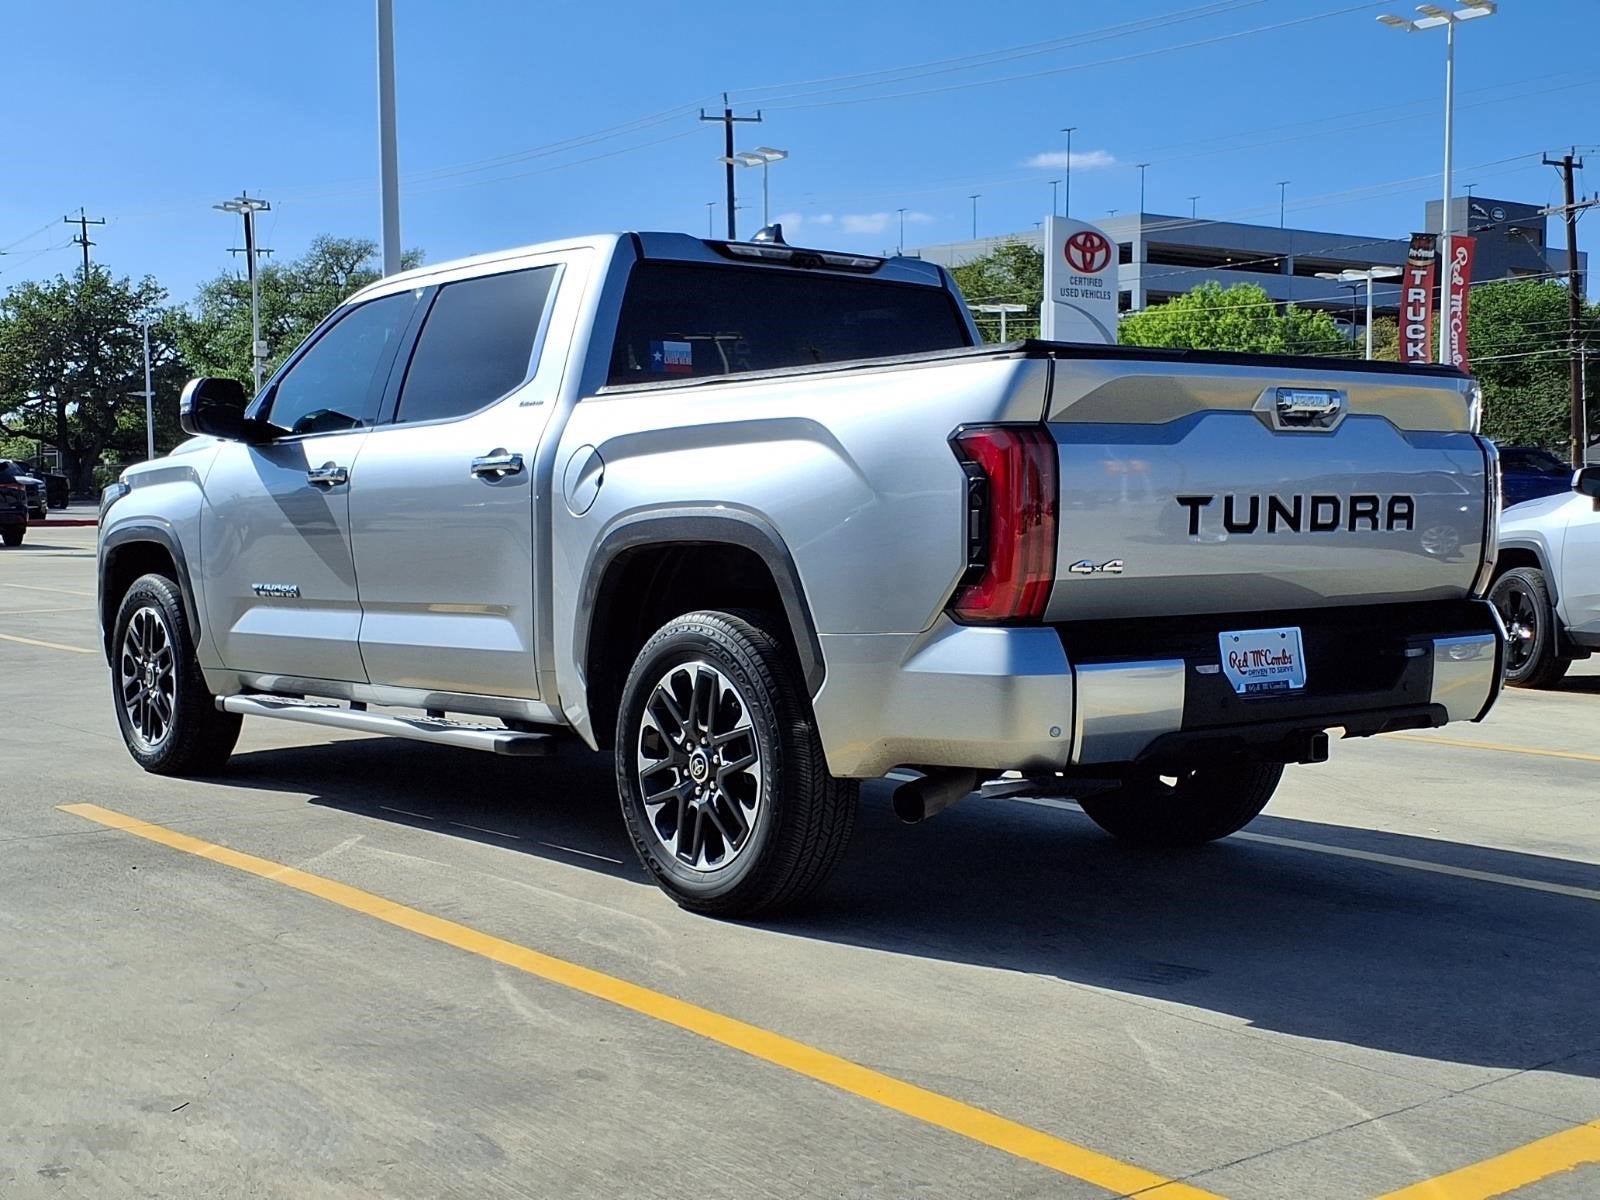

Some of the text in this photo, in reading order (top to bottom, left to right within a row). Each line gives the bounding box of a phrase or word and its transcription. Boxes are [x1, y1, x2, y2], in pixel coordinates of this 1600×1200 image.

[1060, 288, 1111, 300] USED VEHICLES
[1069, 276, 1103, 287] CERTIFIED
[1406, 270, 1427, 364] TRUCK
[1449, 247, 1468, 367] Red McComb
[1176, 494, 1415, 536] TUNDRA
[1229, 648, 1293, 675] Red McCombs
[1248, 667, 1268, 676] DRIVEN
[1277, 665, 1294, 674] SERVE
